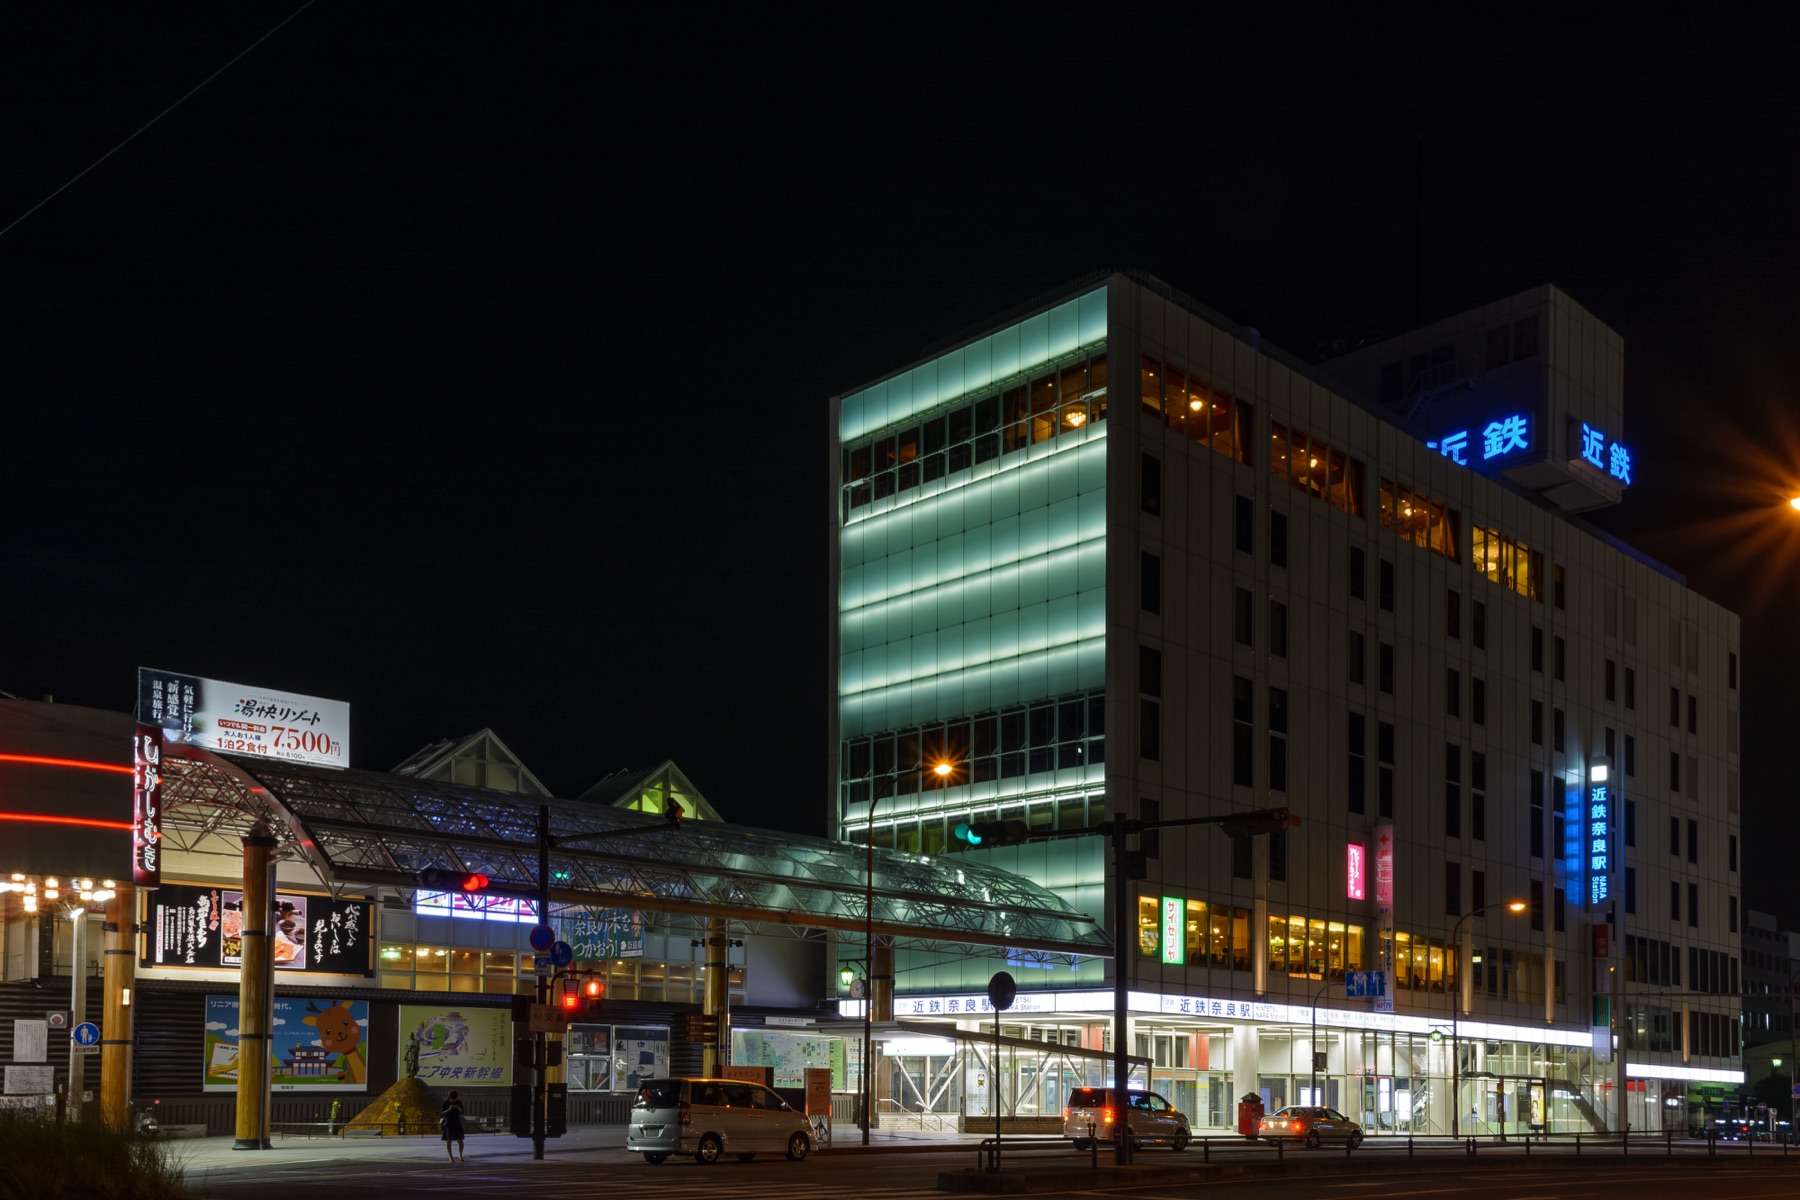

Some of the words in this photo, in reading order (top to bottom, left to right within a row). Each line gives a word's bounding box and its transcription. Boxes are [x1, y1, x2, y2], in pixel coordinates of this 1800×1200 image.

[1583, 423, 1631, 486] 近鉄
[152, 680, 164, 724] 温泉旅行。
[183, 685, 194, 742] 気軽に行ける
[234, 699, 321, 726] 湯快リゾート
[216, 737, 268, 754] 1泊2食付
[223, 730, 262, 742] 大人お1人様
[144, 735, 159, 873] ひがしむき
[1591, 787, 1607, 870] 近鉄奈良駅
[1591, 875, 1600, 905] Station
[1599, 875, 1607, 899] NARA
[574, 912, 632, 936] 奈良の木を
[1167, 900, 1176, 961] サイゼリヤ
[912, 998, 994, 1013] 近鉄奈良駅
[1179, 998, 1251, 1018] 近鉄奈良駅
[1255, 1004, 1279, 1014] KINTETSU
[1376, 1002, 1384, 1010] 4F
[1384, 1002, 1393, 1010] 7F
